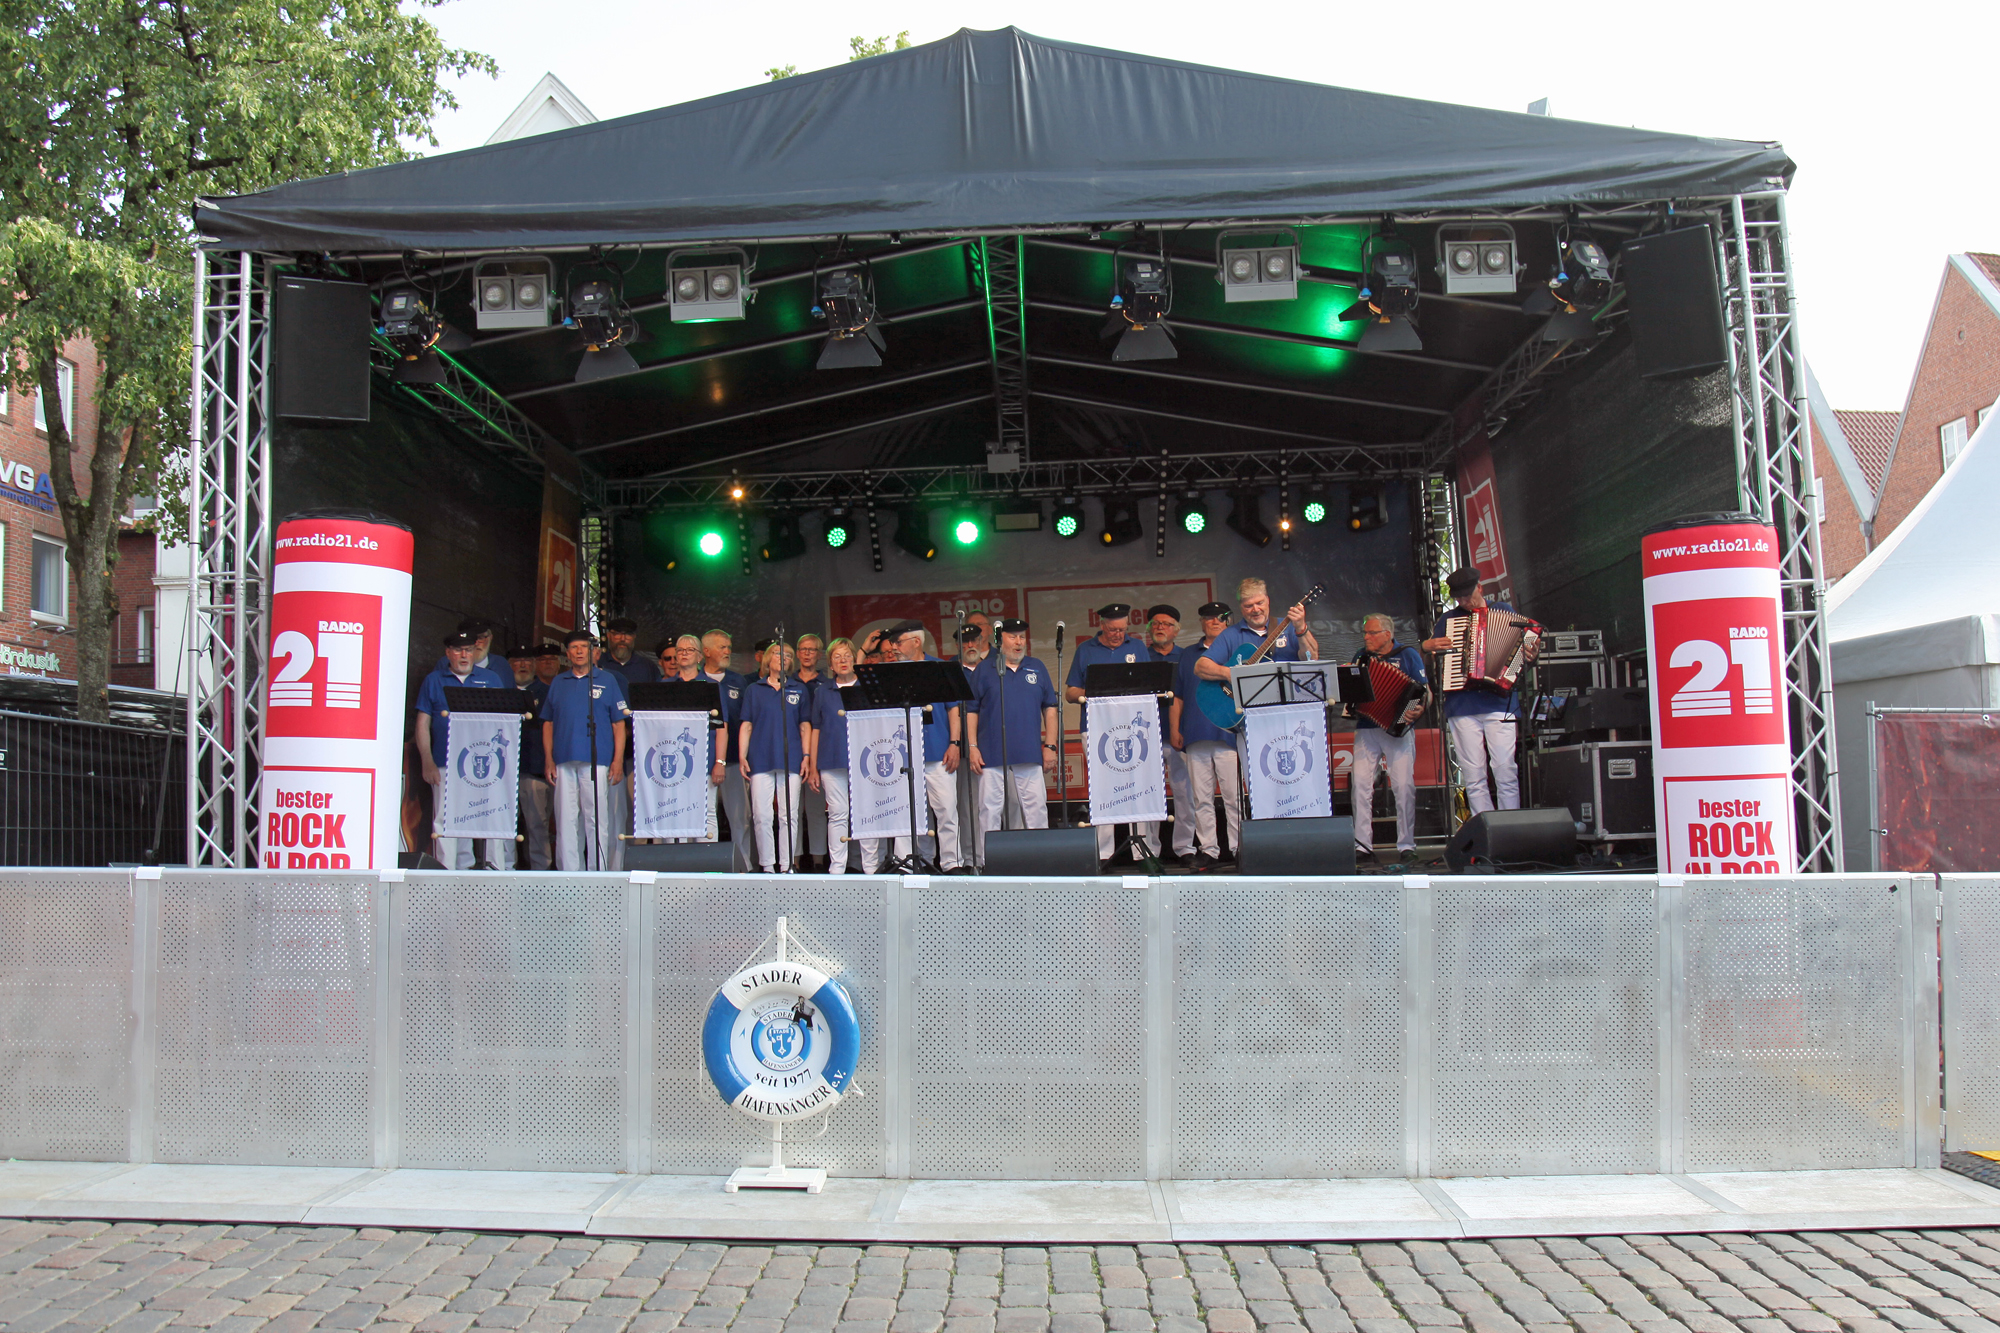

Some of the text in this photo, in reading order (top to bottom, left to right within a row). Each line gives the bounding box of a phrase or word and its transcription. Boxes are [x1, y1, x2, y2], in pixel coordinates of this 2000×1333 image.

[1652, 538, 1769, 560] www.radio21.de
[318, 620, 364, 634] RADIO
[1729, 627, 1768, 638] RADIO
[269, 630, 364, 709] 21
[1669, 639, 1773, 718] 21
[1113, 782, 1135, 794] Stader
[276, 788, 333, 809] bester
[468, 798, 489, 808] Stader
[657, 797, 677, 809] Stader
[875, 796, 897, 808] Stader
[1099, 791, 1142, 811] Hafensänger
[1276, 794, 1300, 808] Stader
[453, 808, 496, 824] Hafensänger
[861, 806, 905, 825] Hafensänger
[1698, 799, 1760, 818] bester
[268, 812, 347, 848] ROCK
[1688, 821, 1775, 858] ROCK
[741, 969, 803, 993] STADER
[763, 1010, 793, 1023] STADER
[754, 1068, 812, 1088] seit 1977
[740, 1069, 848, 1116] HAFENSÄNGER e.V.
